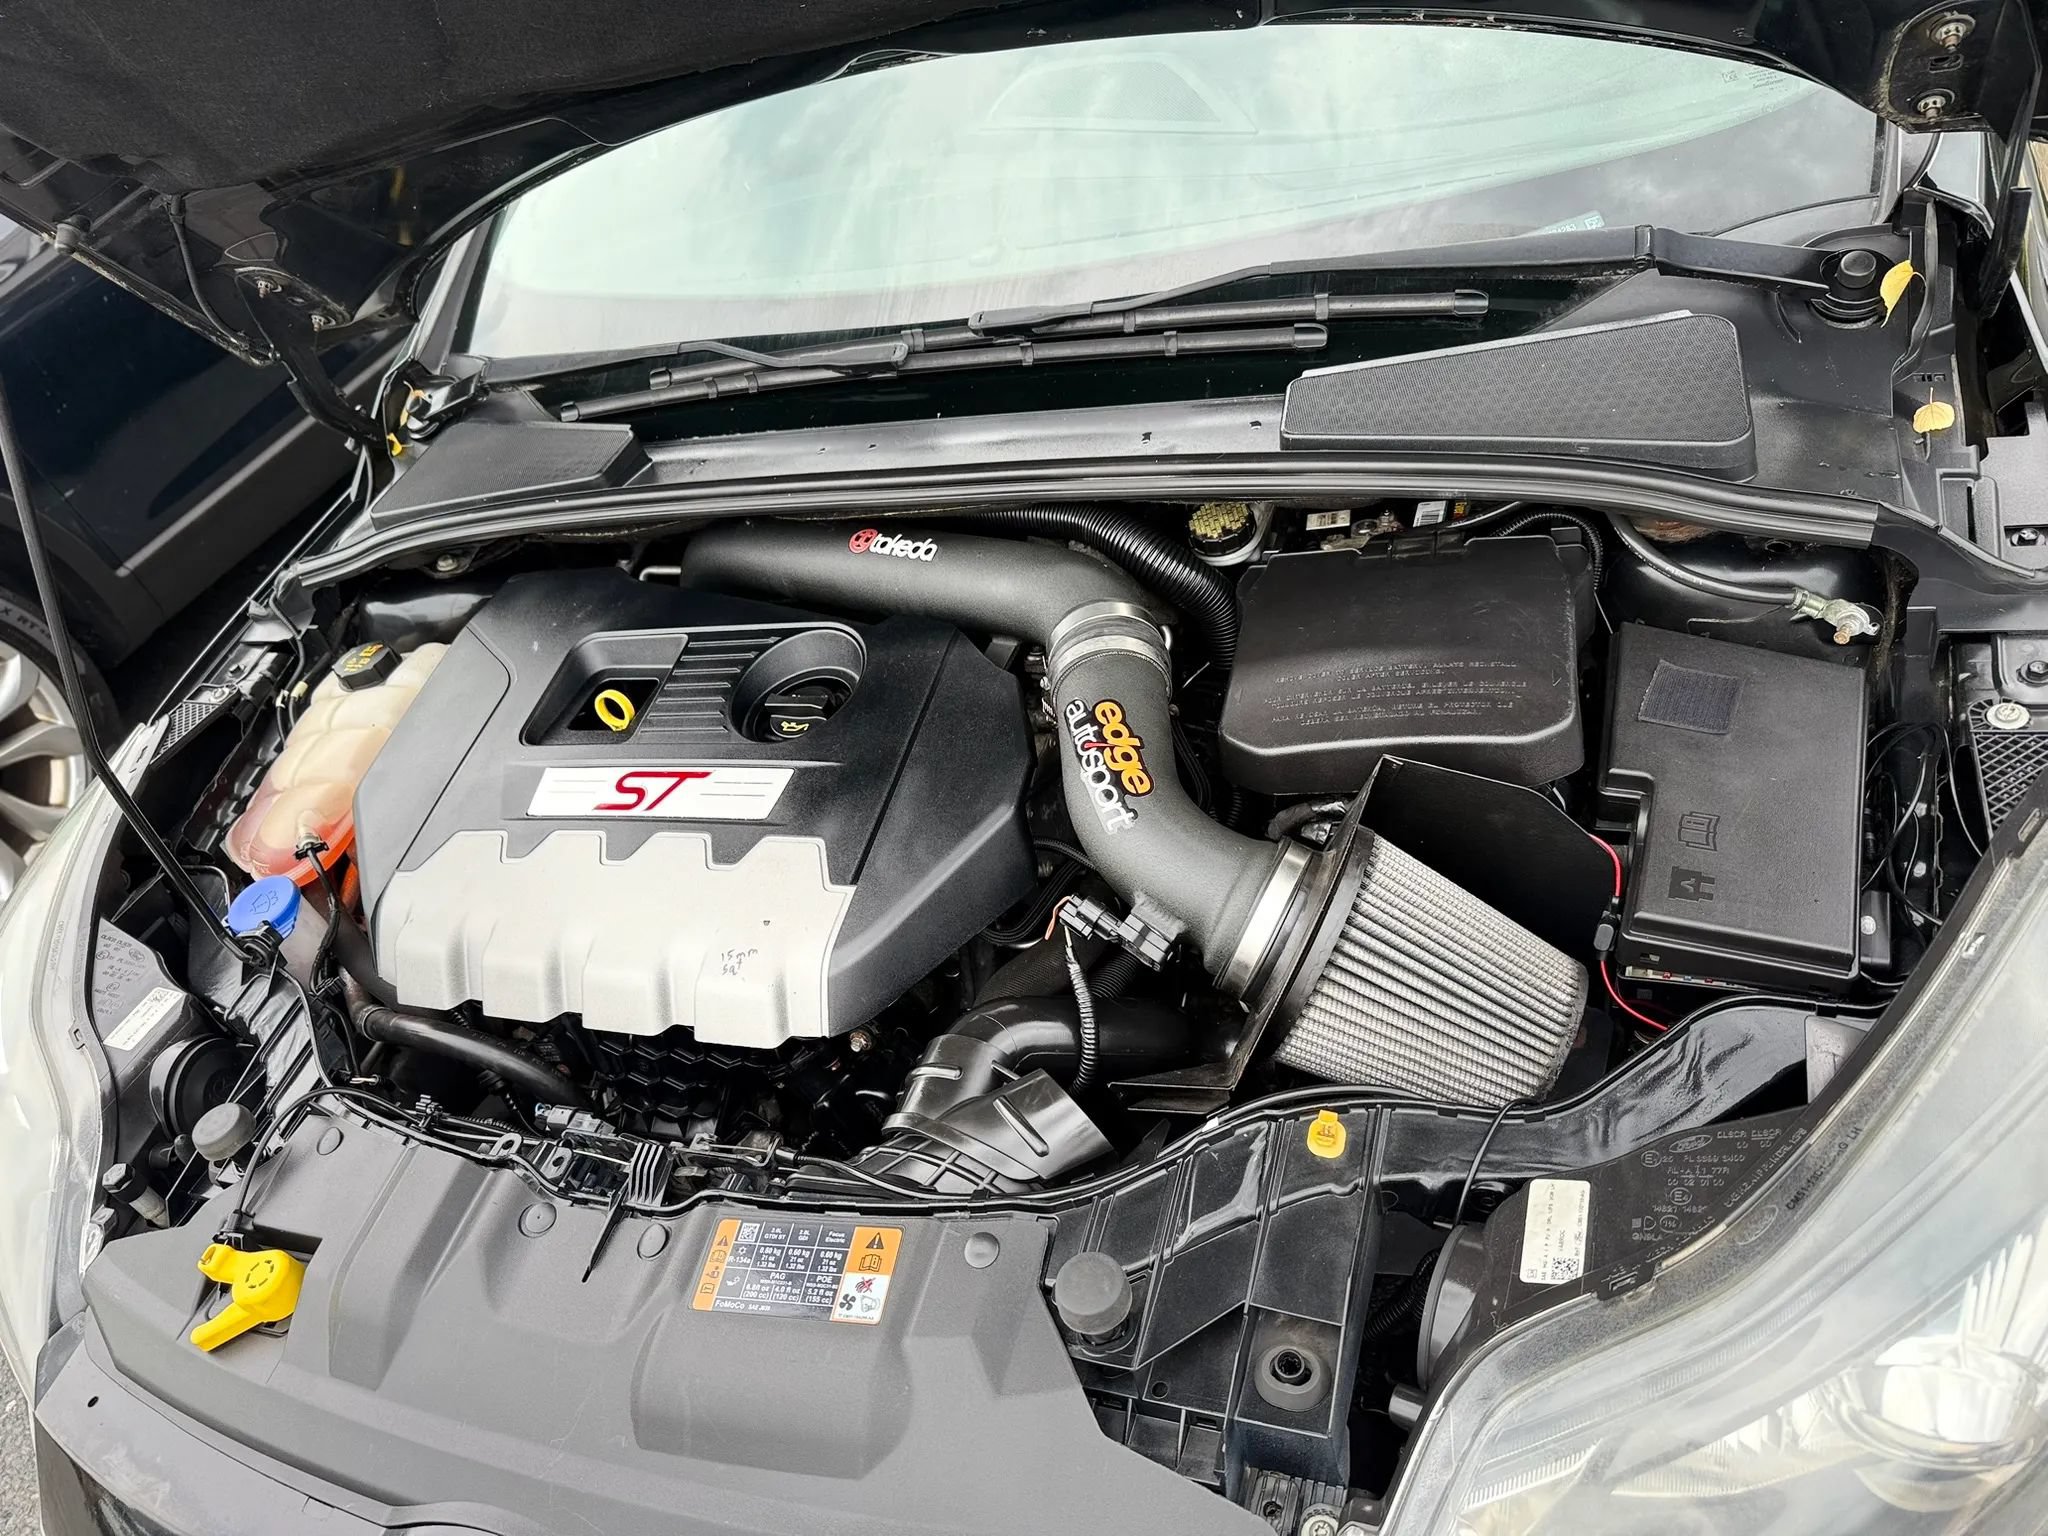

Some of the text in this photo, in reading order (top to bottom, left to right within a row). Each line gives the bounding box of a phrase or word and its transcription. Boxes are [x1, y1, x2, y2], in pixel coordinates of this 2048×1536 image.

[869, 533, 938, 561] takeda
[1095, 701, 1151, 794] edge
[1066, 700, 1135, 831] autosport
[592, 771, 713, 811] ST
[774, 1248, 781, 1256] kg
[802, 1249, 810, 1258] kg
[834, 1251, 842, 1260] kg
[728, 1255, 751, 1264] R-134a
[769, 1272, 786, 1280] PAG
[816, 1276, 833, 1284] POE
[774, 1285, 785, 1293] 4.0
[772, 1293, 800, 1302] (120 cc)
[805, 1295, 821, 1303] (155
[715, 1300, 745, 1309] FoMoCo
